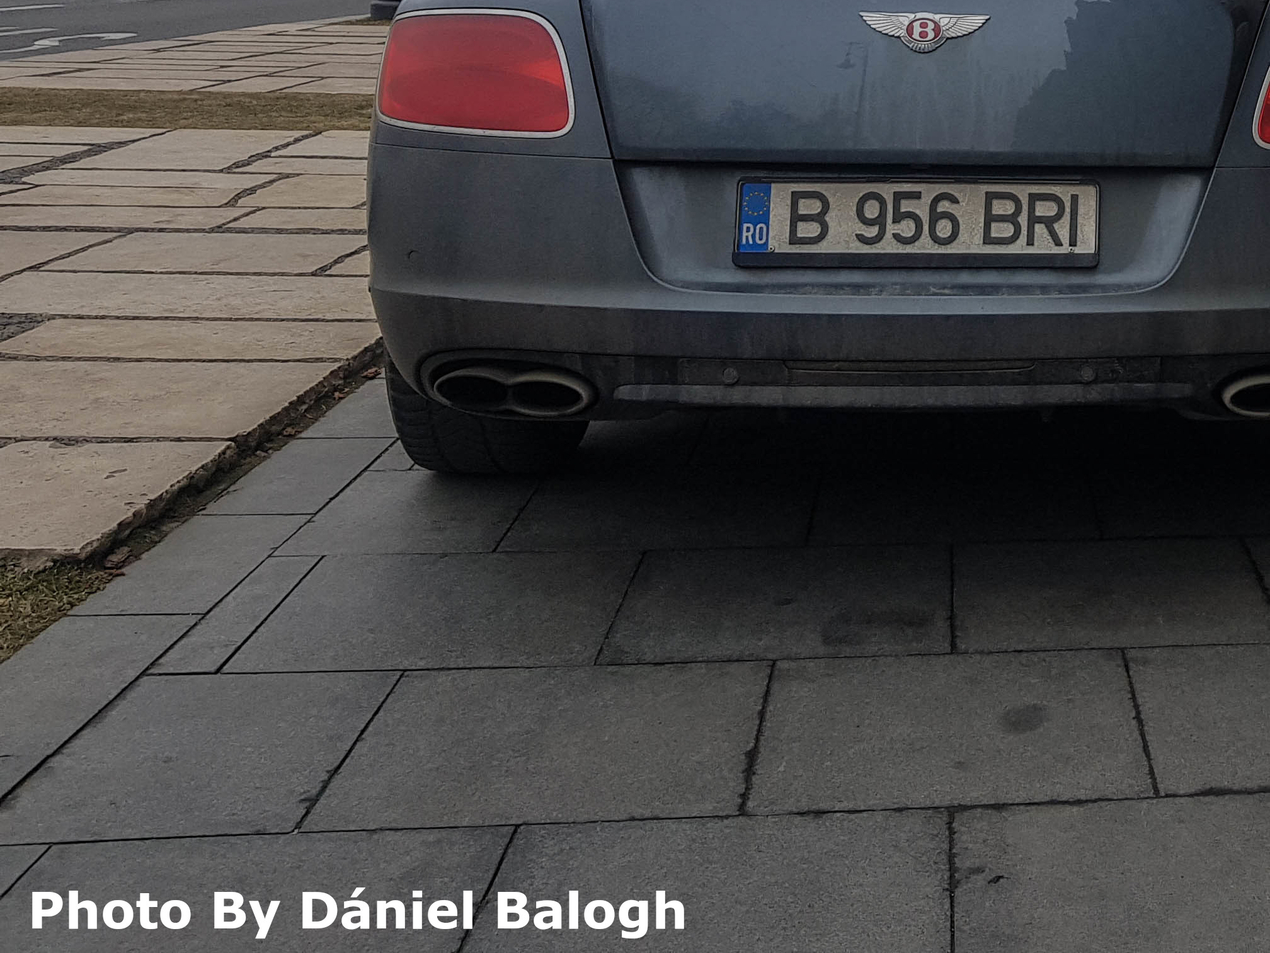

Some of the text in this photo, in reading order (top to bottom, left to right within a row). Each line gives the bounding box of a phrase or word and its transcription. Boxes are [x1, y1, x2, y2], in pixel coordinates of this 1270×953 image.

[742, 223, 767, 245] RO
[788, 190, 1079, 247] B 956 BRI
